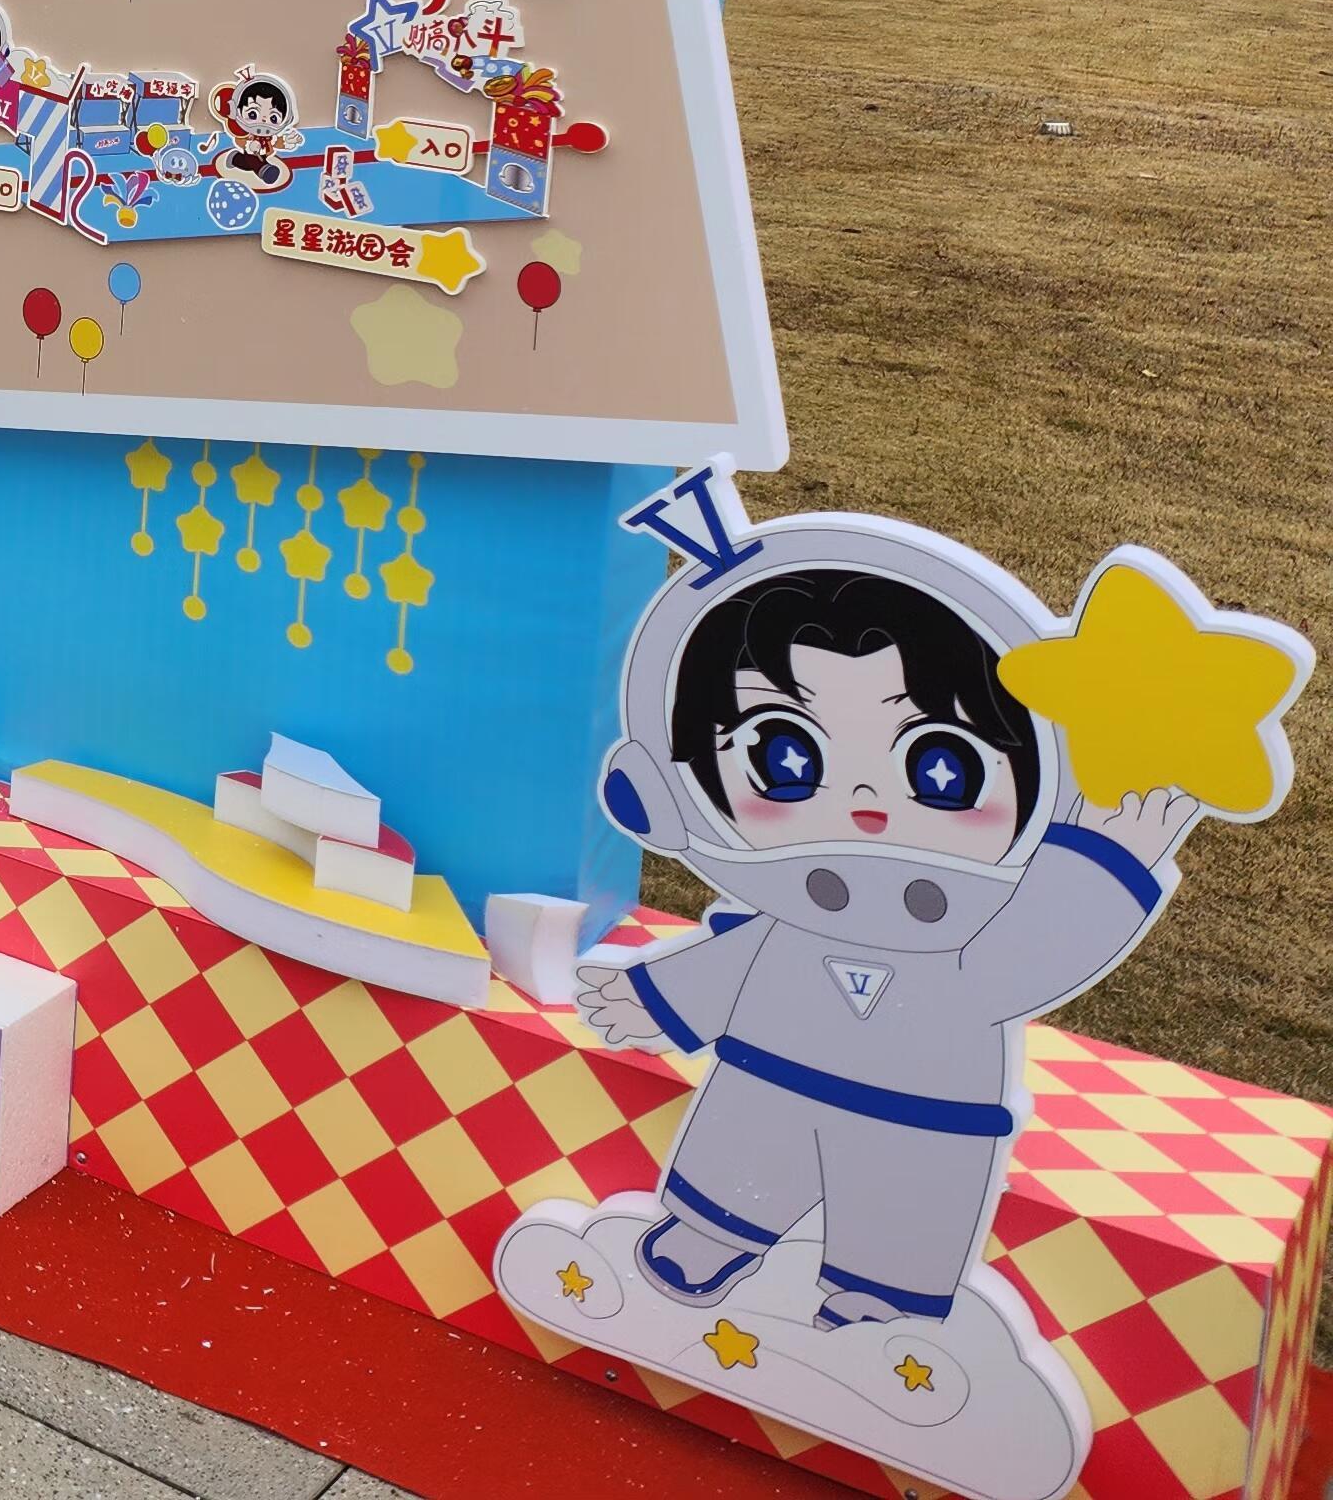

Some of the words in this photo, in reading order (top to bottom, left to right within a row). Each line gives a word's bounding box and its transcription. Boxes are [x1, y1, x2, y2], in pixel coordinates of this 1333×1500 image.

[152, 79, 193, 97] 写福字
[420, 138, 463, 159] 入口
[272, 218, 416, 269] 星星游园会
